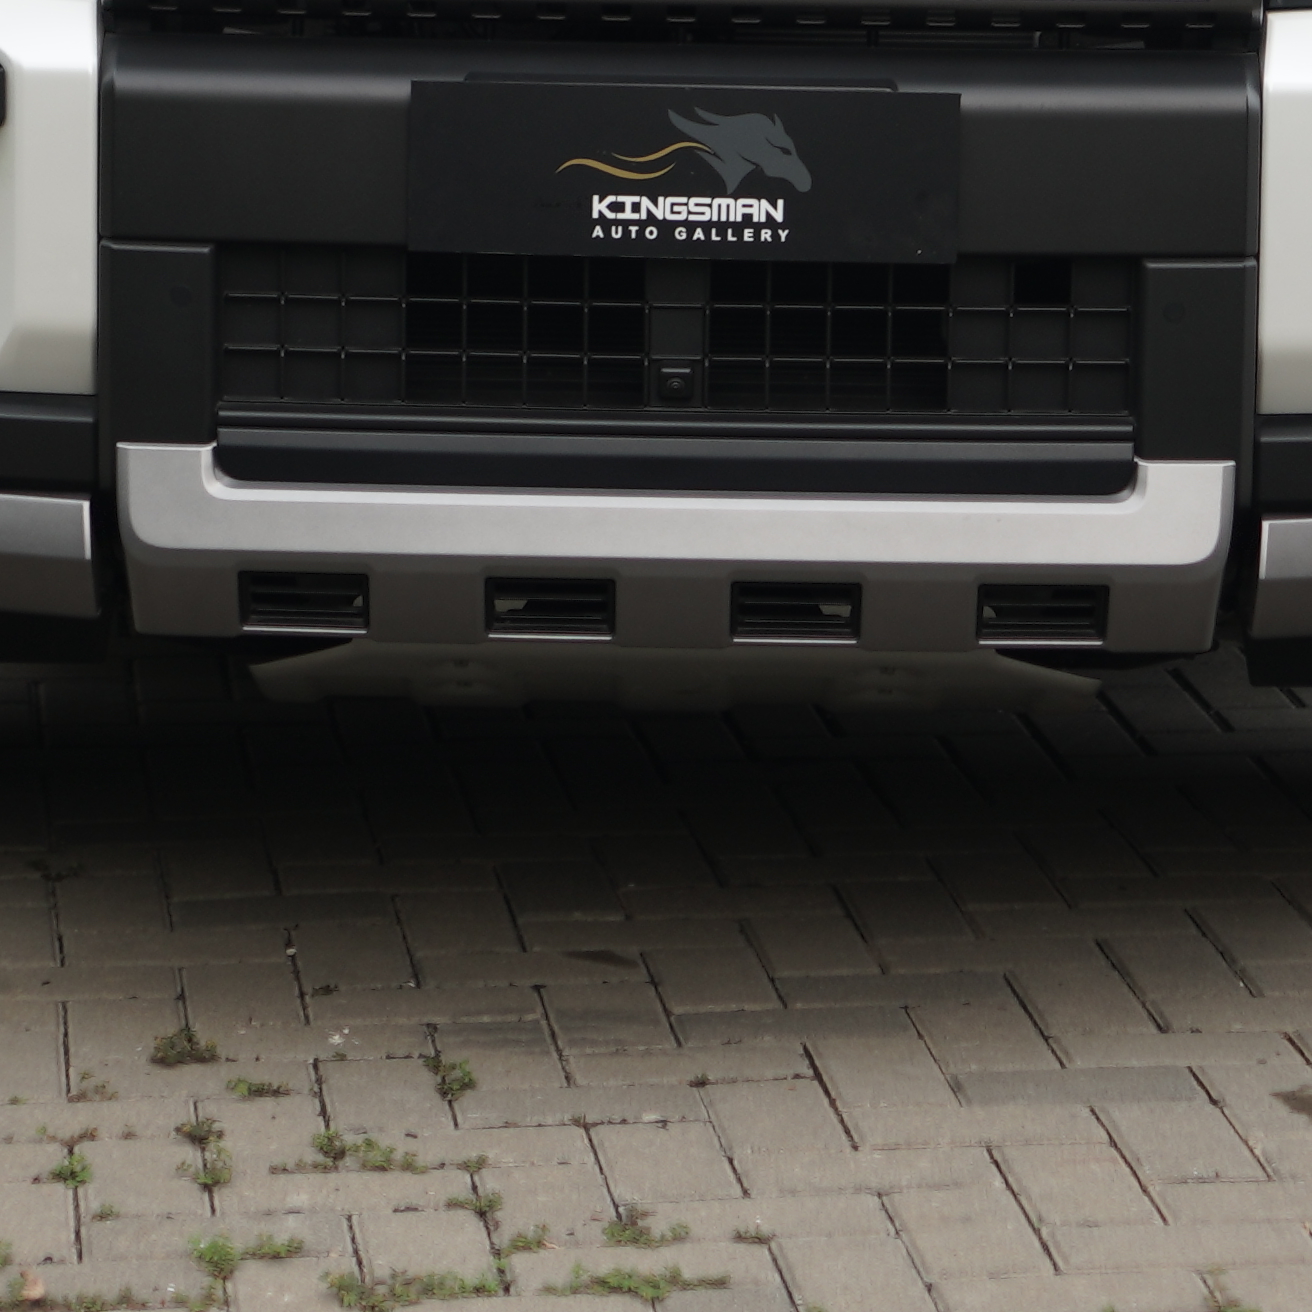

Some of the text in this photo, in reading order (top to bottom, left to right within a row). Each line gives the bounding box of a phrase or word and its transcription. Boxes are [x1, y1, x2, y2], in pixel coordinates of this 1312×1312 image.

[591, 194, 785, 223] KINGSMAN
[591, 224, 790, 243] AUTO GALLERY
